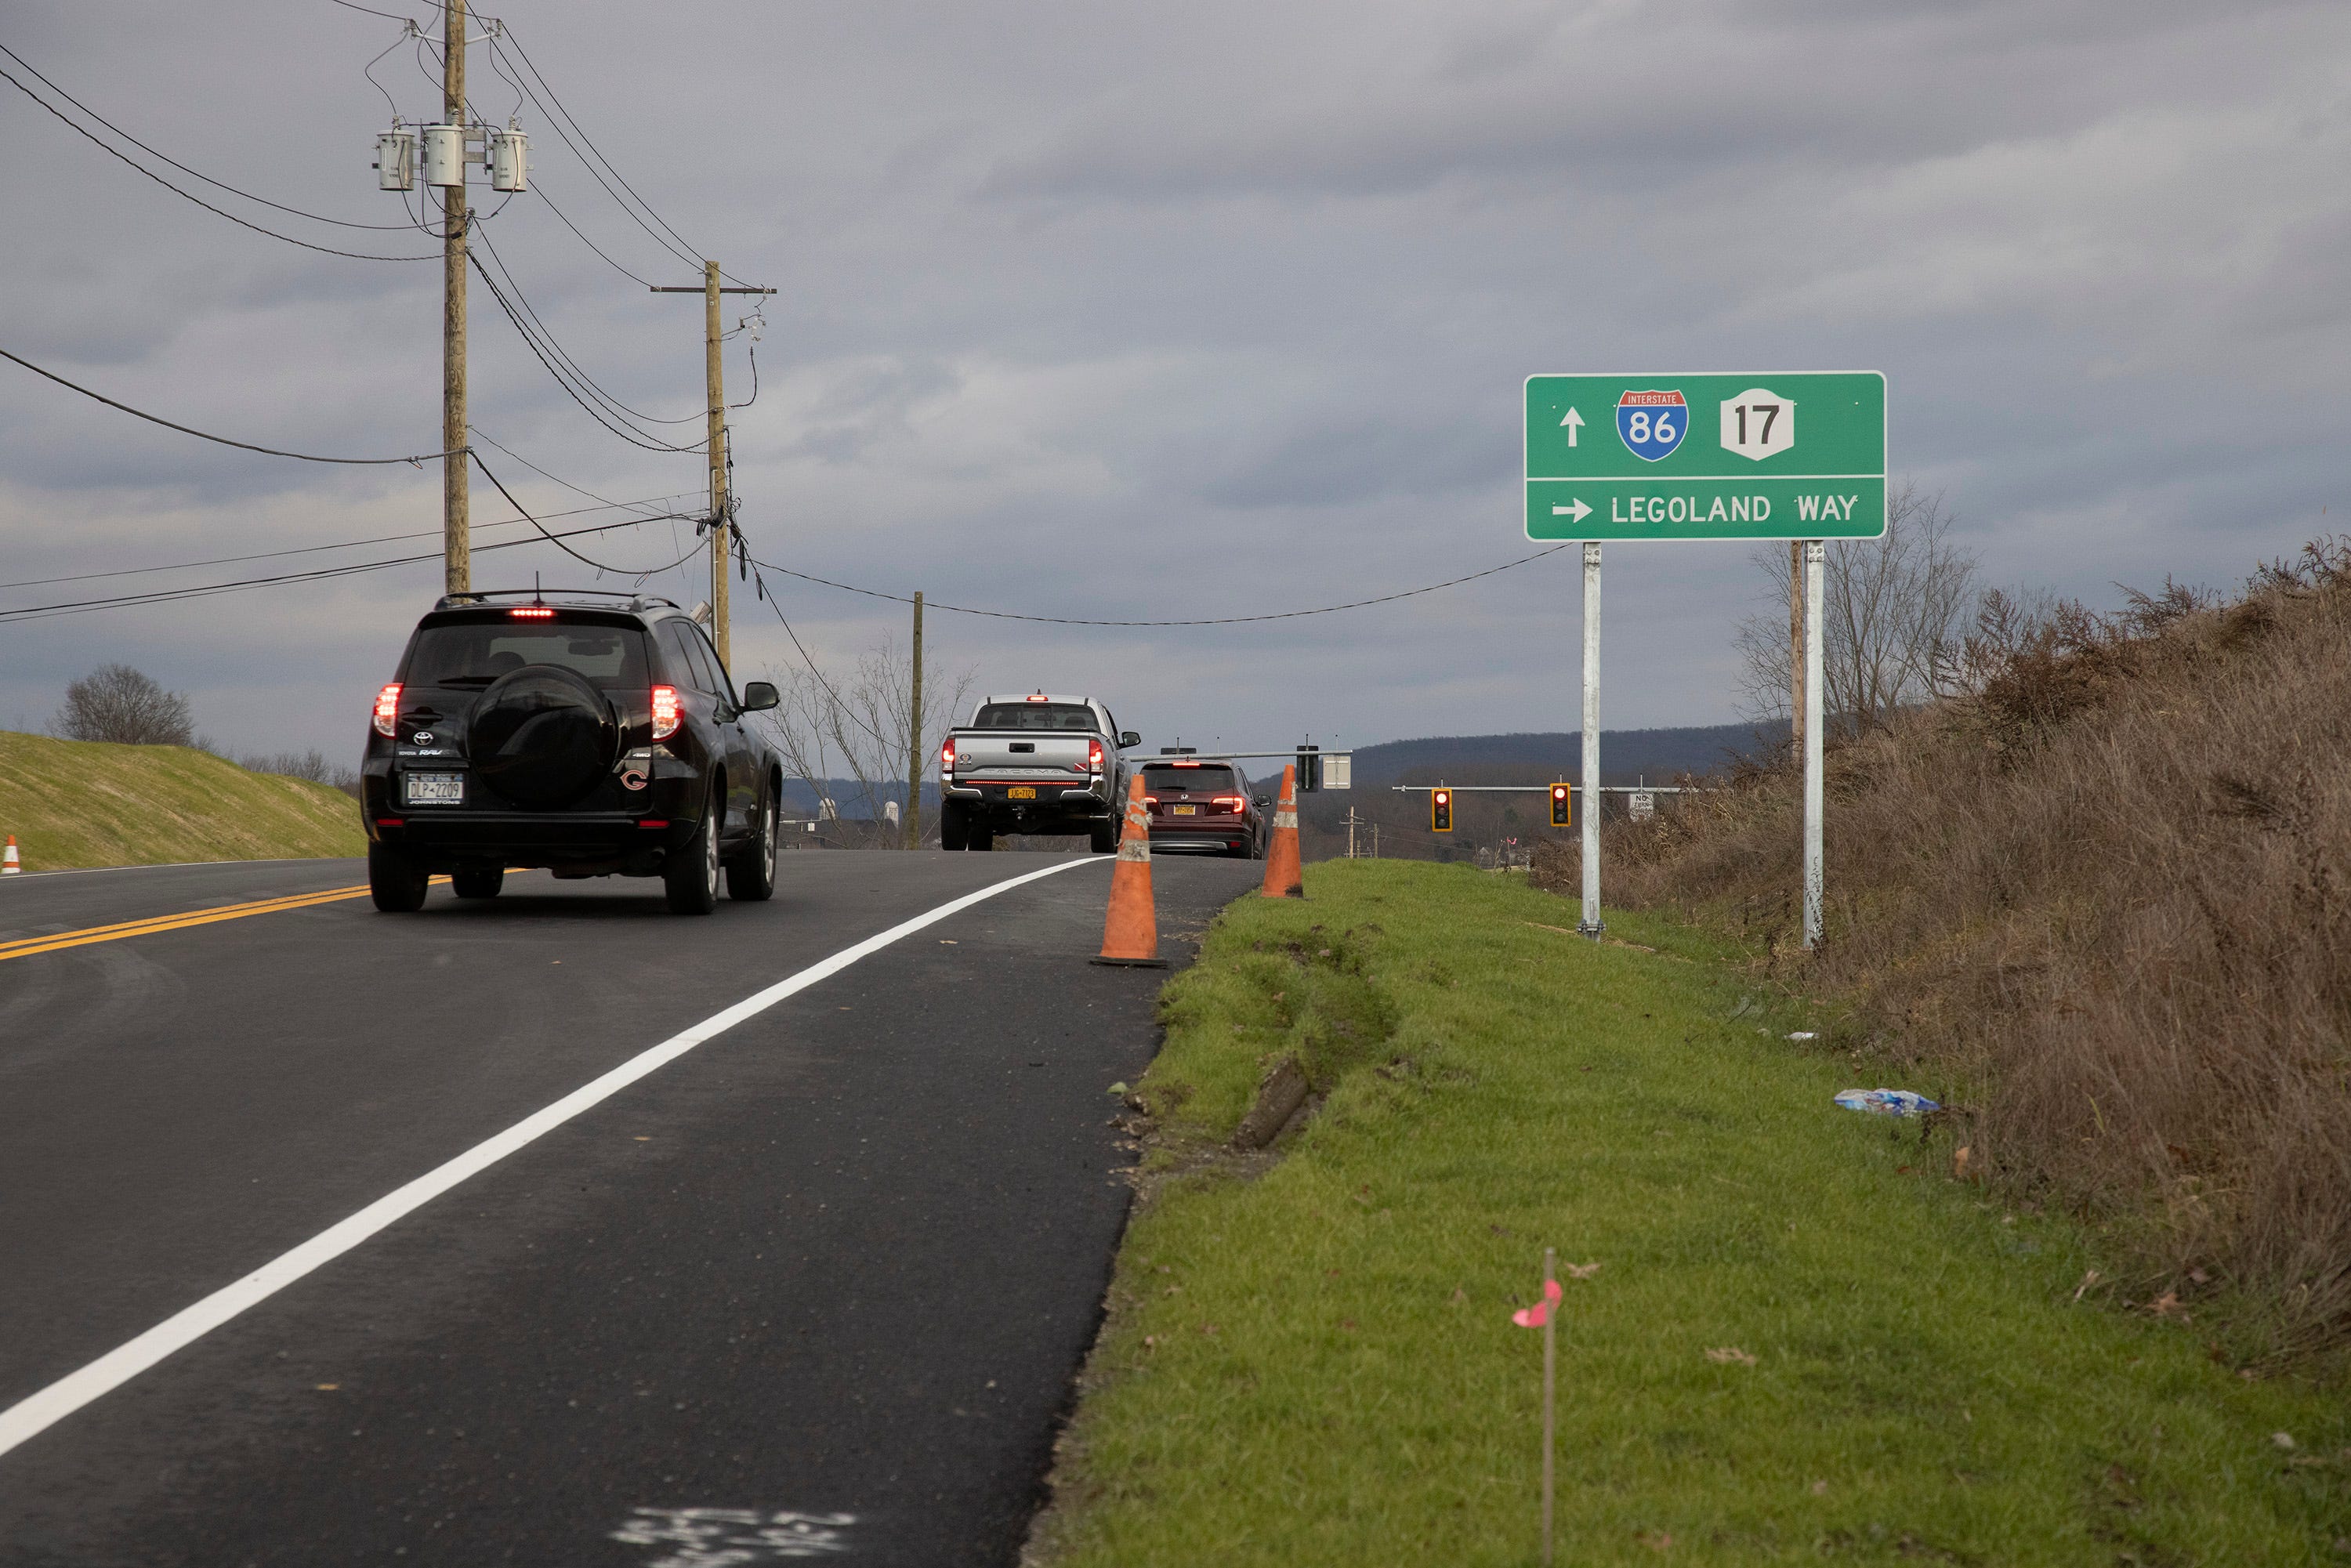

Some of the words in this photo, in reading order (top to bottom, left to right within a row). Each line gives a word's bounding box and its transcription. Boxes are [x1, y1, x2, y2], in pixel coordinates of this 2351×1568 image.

[1628, 394, 1677, 404] INTERSTATE
[1629, 411, 1676, 444] 86
[1735, 404, 1780, 445] 17
[1612, 495, 1771, 523] LEGOLAND
[1798, 494, 1857, 521] WAY
